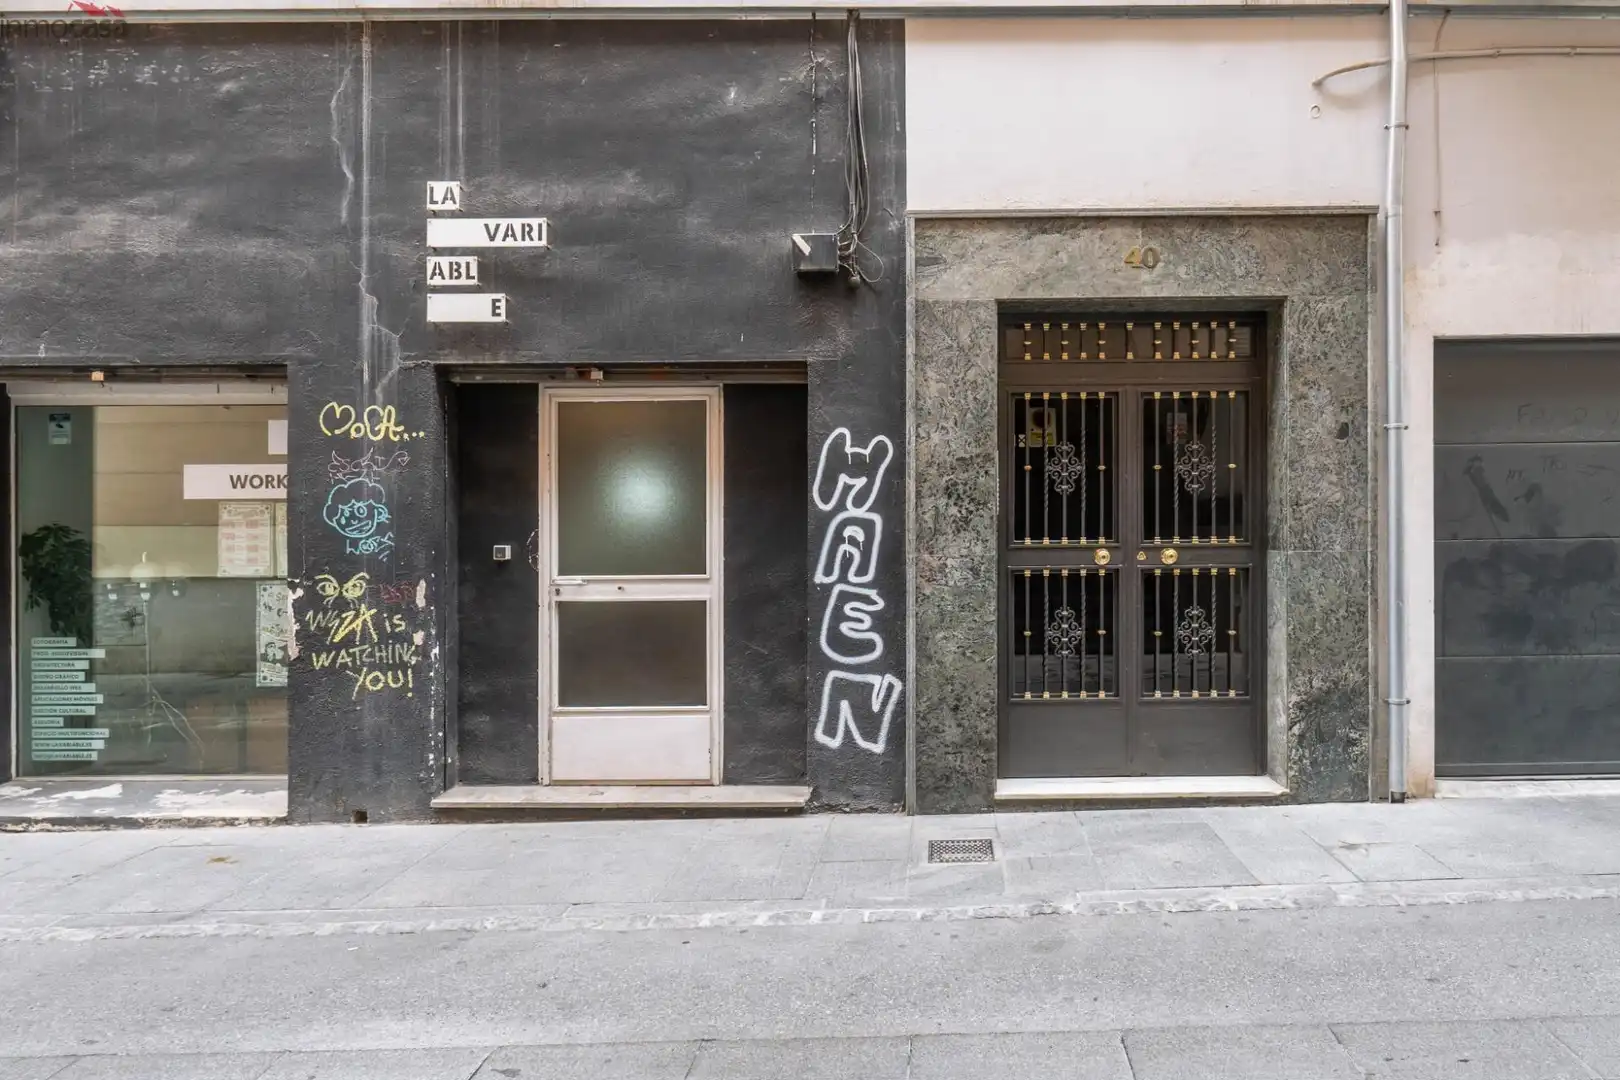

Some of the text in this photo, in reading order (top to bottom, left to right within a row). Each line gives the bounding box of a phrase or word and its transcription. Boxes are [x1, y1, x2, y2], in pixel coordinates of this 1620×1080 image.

[428, 186, 457, 205] LA
[483, 223, 543, 242] VARI
[1123, 245, 1161, 269] 40
[429, 261, 476, 281] ABL
[491, 298, 502, 317] E
[229, 474, 288, 490] WORK
[311, 640, 419, 670] WATCHING
[345, 667, 414, 700] YOU!
